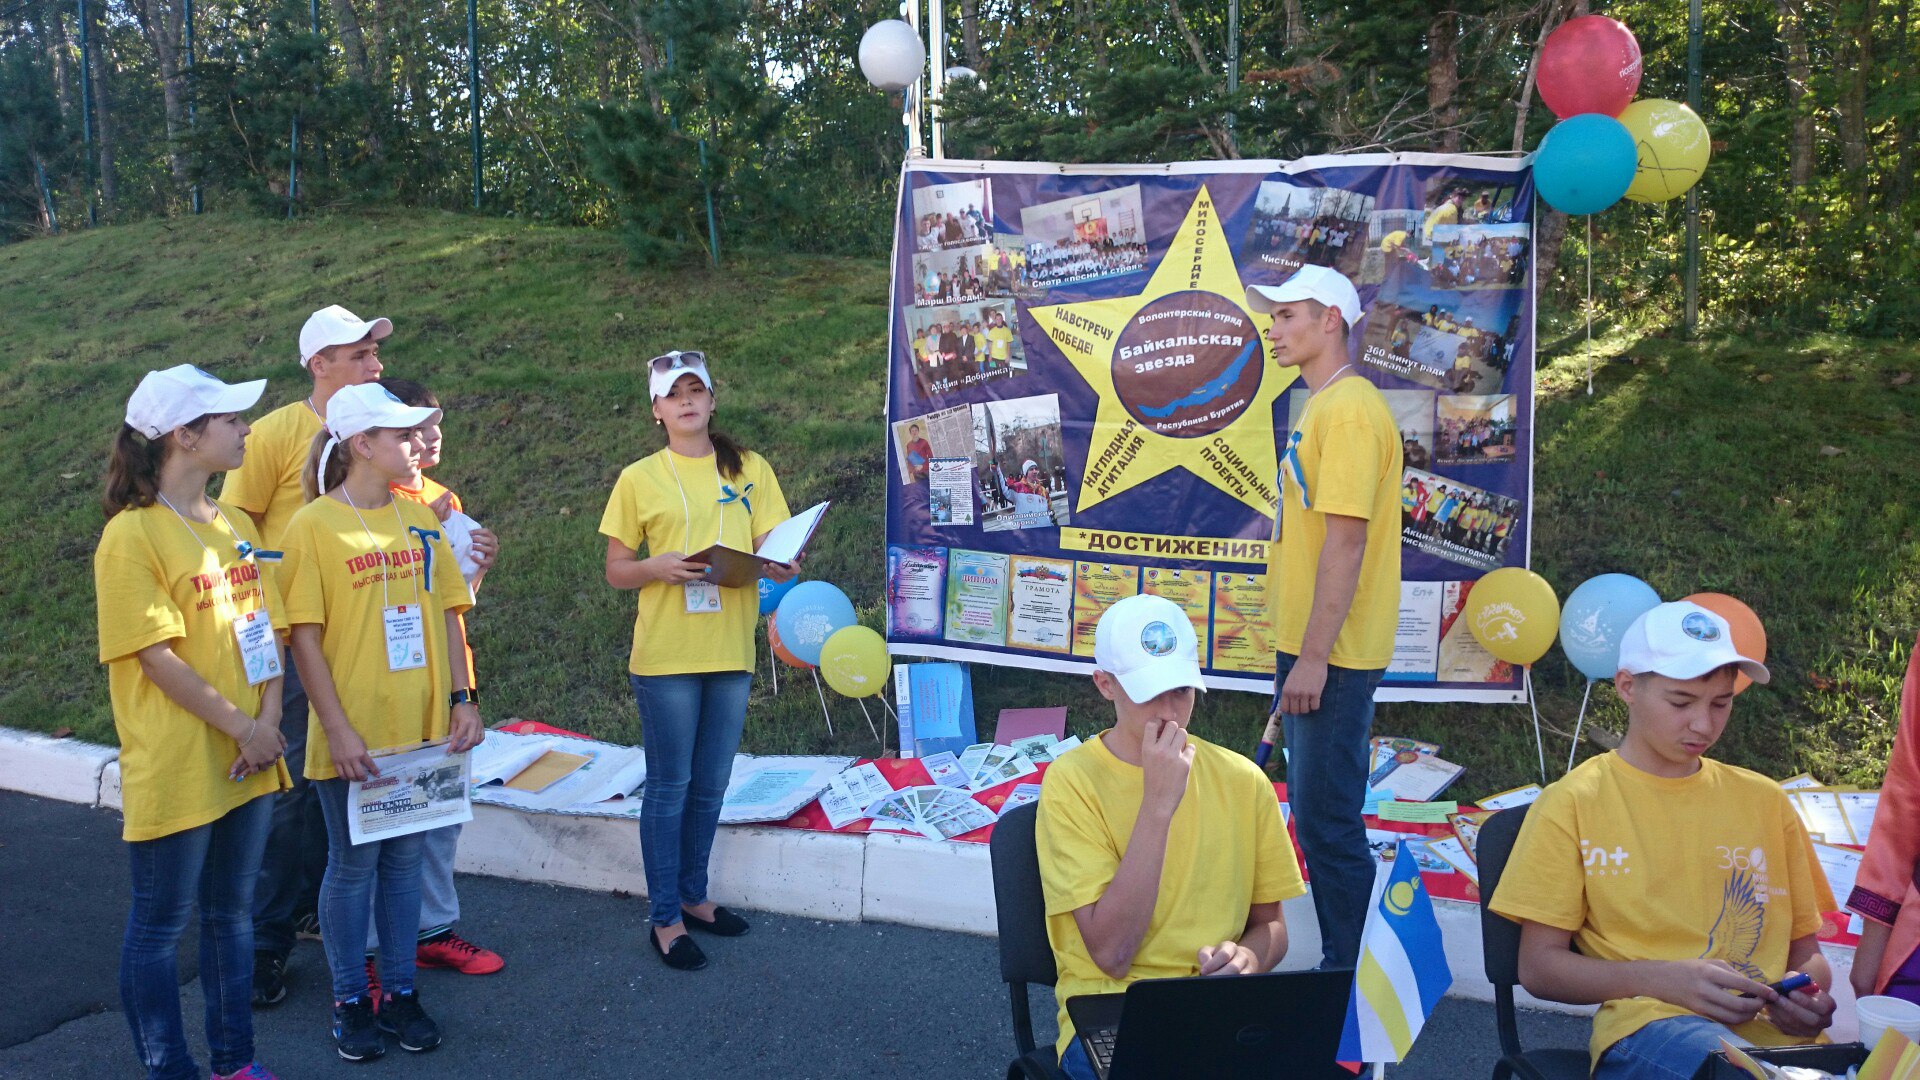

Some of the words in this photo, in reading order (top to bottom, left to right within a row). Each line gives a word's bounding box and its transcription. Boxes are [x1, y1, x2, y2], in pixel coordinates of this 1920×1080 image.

[1190, 201, 1210, 288] МИЛОСЕРДИЕ
[1032, 278, 1062, 288] Смотр
[1064, 272, 1099, 283] «песни
[1110, 263, 1143, 274] строя»
[917, 298, 944, 307] Марш
[946, 292, 984, 304] Победы!
[1055, 307, 1113, 341] НАВСТРЕЧУ
[1138, 309, 1211, 325] Волонтерский
[1213, 312, 1243, 327] отряд
[1051, 327, 1094, 355] ПОБЕДЕ!
[1119, 334, 1243, 360] Байкальская
[1134, 354, 1195, 374] звезда
[1366, 345, 1386, 357] 360
[1387, 352, 1419, 369] минут
[1420, 363, 1446, 377] ради
[931, 380, 959, 392] Акция
[1156, 414, 1209, 430] Республика
[1210, 399, 1245, 419] Бурятия
[1083, 419, 1138, 488] НАГЛЯДНАЯ
[1097, 435, 1145, 498] АГИТАЦИЯ
[1200, 447, 1249, 498] ПРОЕКТЫ
[1213, 437, 1280, 510] СОЦИАЛЬНЫЕ
[1079, 531, 1270, 559] ДОСТИЖЕНИЯ
[1401, 535, 1438, 554] письмо
[1403, 526, 1435, 543] Акция
[1437, 537, 1496, 562] «Новогоднее
[345, 551, 391, 575] ТВОРИ
[391, 547, 426, 569] ДОБР
[400, 567, 425, 579] ШКОЛ
[229, 563, 261, 587] ДОБ
[962, 574, 998, 585] ДИПЛОМ
[1025, 585, 1060, 594] ГРАМОТА
[1586, 867, 1631, 876] ROUP
